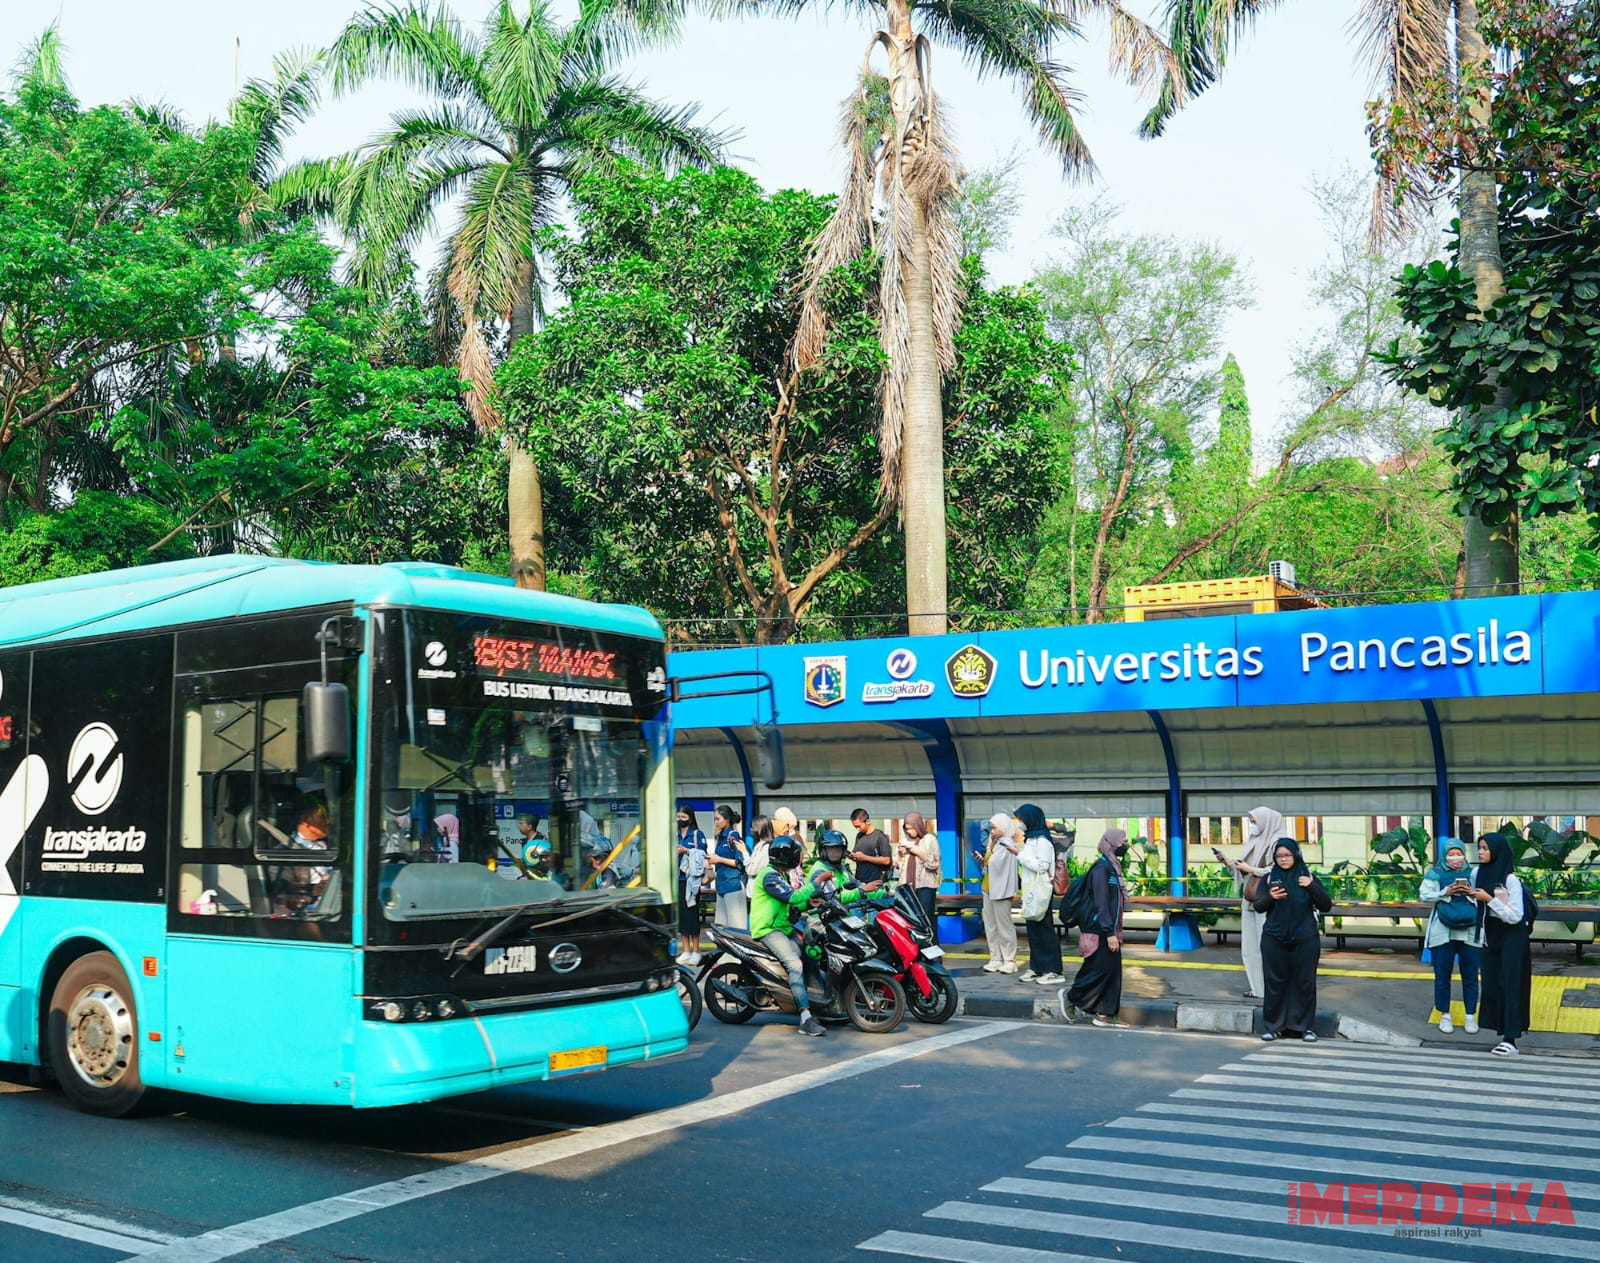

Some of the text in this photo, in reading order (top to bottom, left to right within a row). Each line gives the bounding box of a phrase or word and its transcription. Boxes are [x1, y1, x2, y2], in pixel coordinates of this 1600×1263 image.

[1019, 619, 1532, 688] Universitas Pancasila
[483, 680, 510, 697] BUS
[510, 682, 552, 700] LISTRIK
[865, 682, 930, 698] transjakarta
[42, 826, 146, 859] transjakarta
